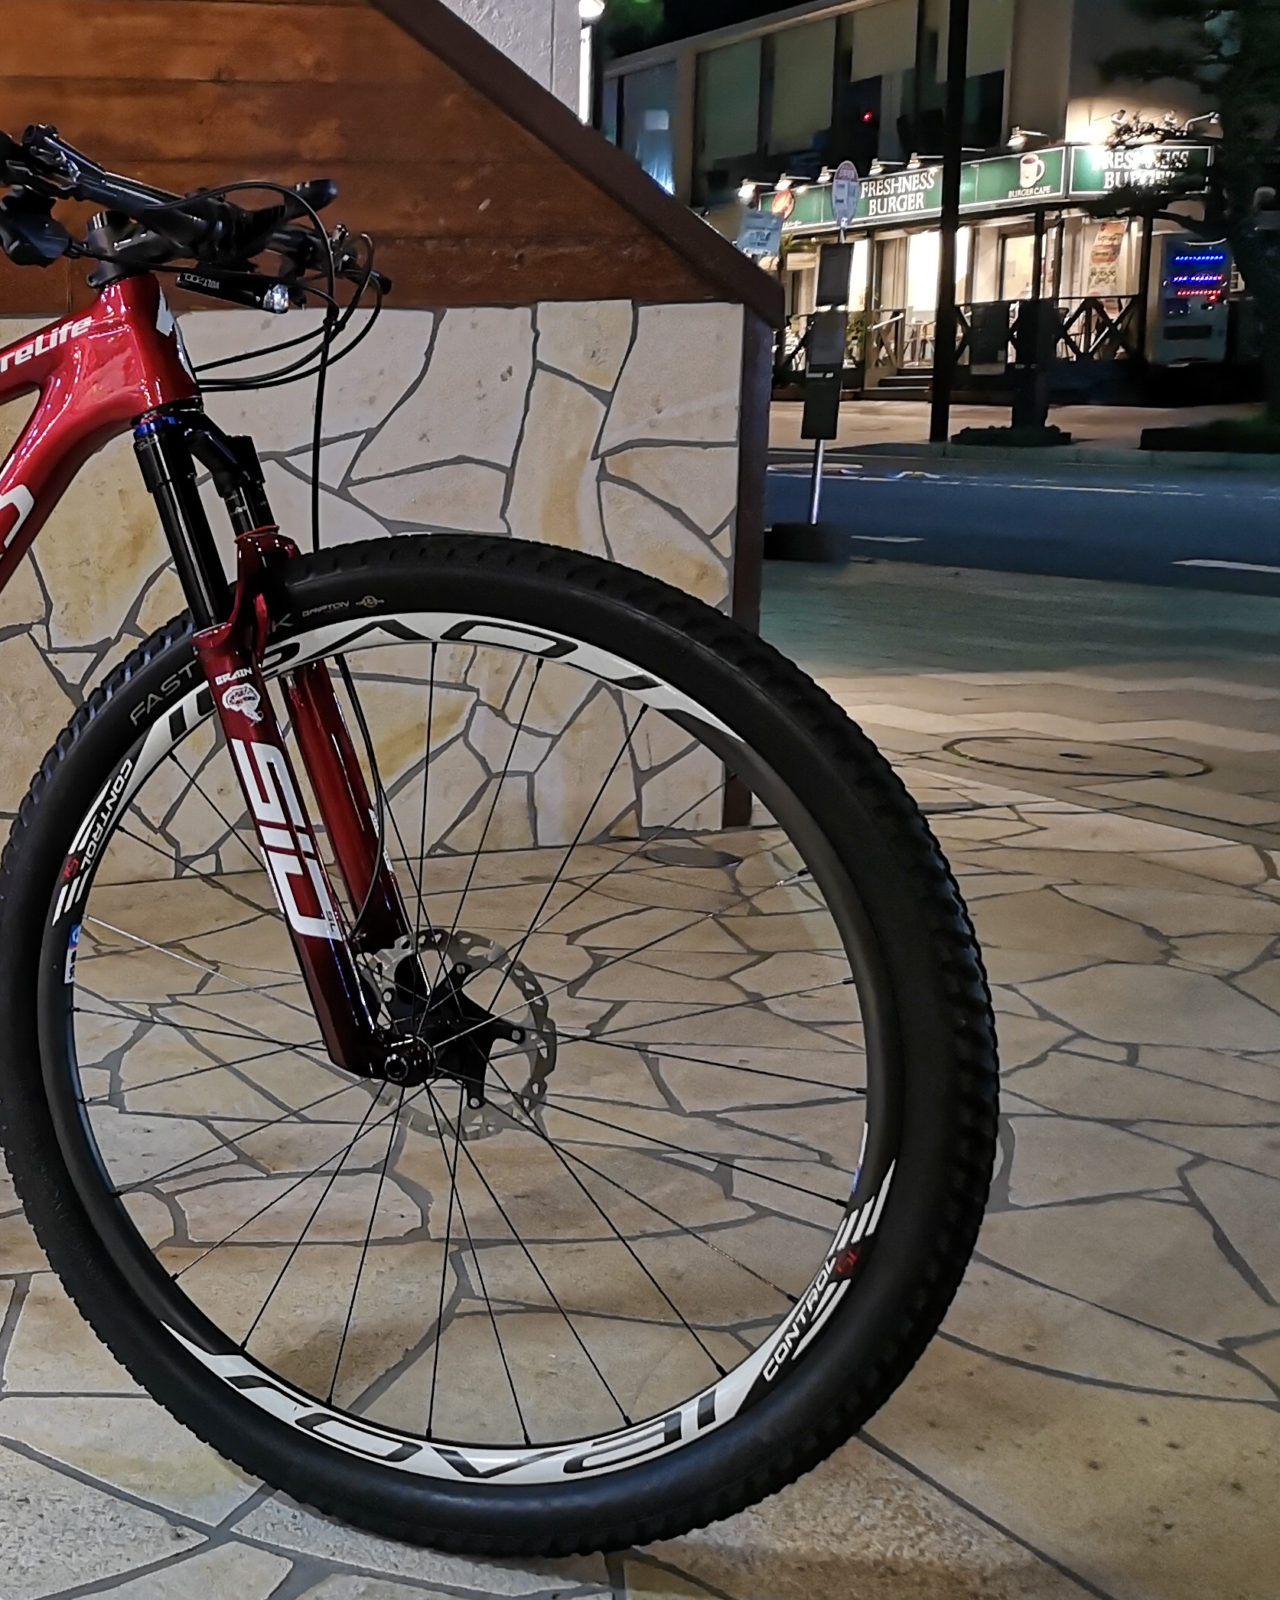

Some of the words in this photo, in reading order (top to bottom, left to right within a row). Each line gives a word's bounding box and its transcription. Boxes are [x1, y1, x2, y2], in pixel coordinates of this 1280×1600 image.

[861, 171, 935, 199] FRESHNESS
[869, 192, 925, 216] BURGER
[130, 659, 197, 726] FAST
[80, 758, 133, 870] CONTROL
[763, 1257, 837, 1382] CONTROL
